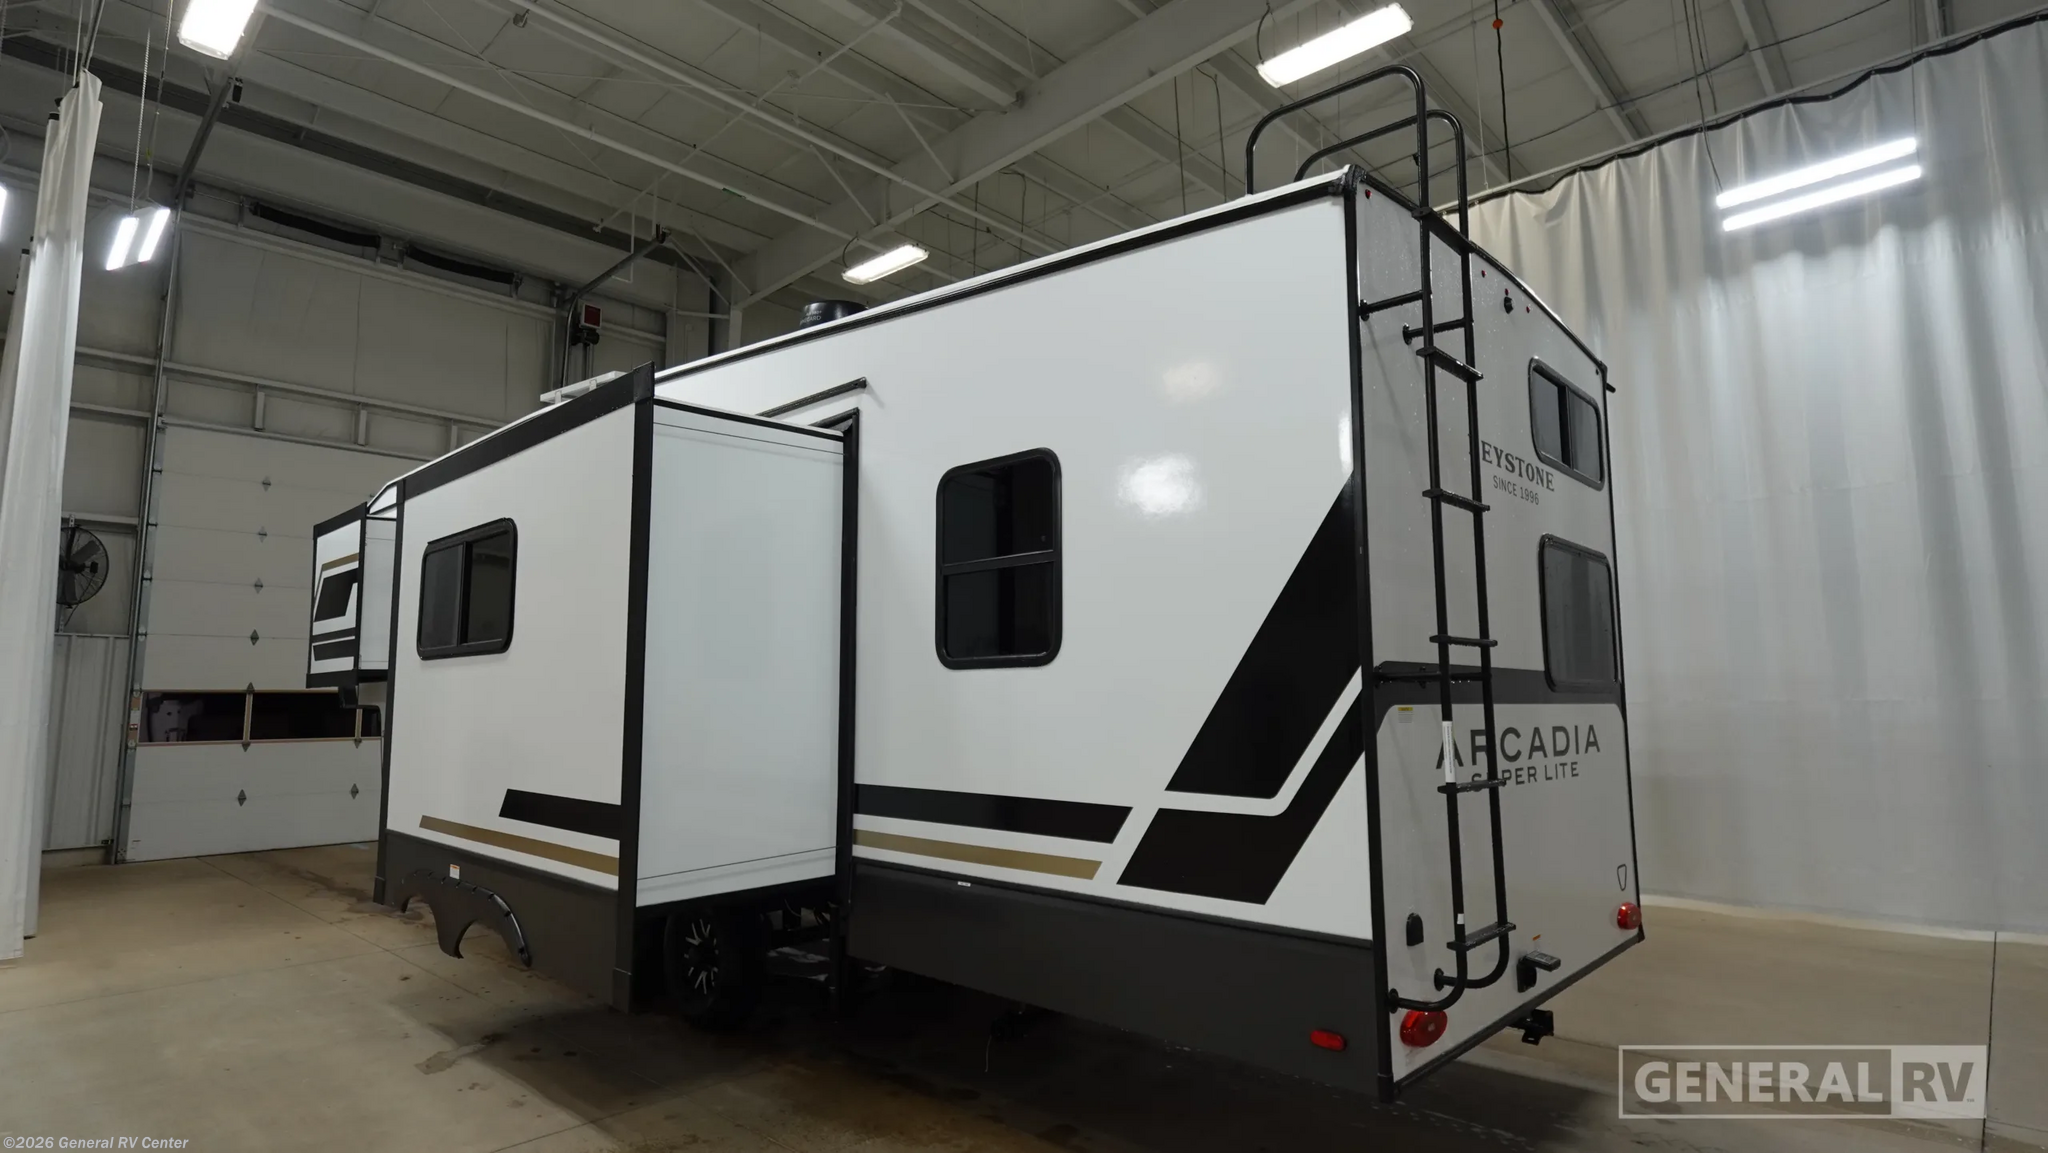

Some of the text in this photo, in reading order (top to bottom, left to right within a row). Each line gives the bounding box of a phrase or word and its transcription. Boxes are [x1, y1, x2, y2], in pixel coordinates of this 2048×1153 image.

[1468, 434, 1555, 492] EYSTONE
[1493, 475, 1540, 506] SINCE 1996
[1544, 761, 1579, 781] LITE
